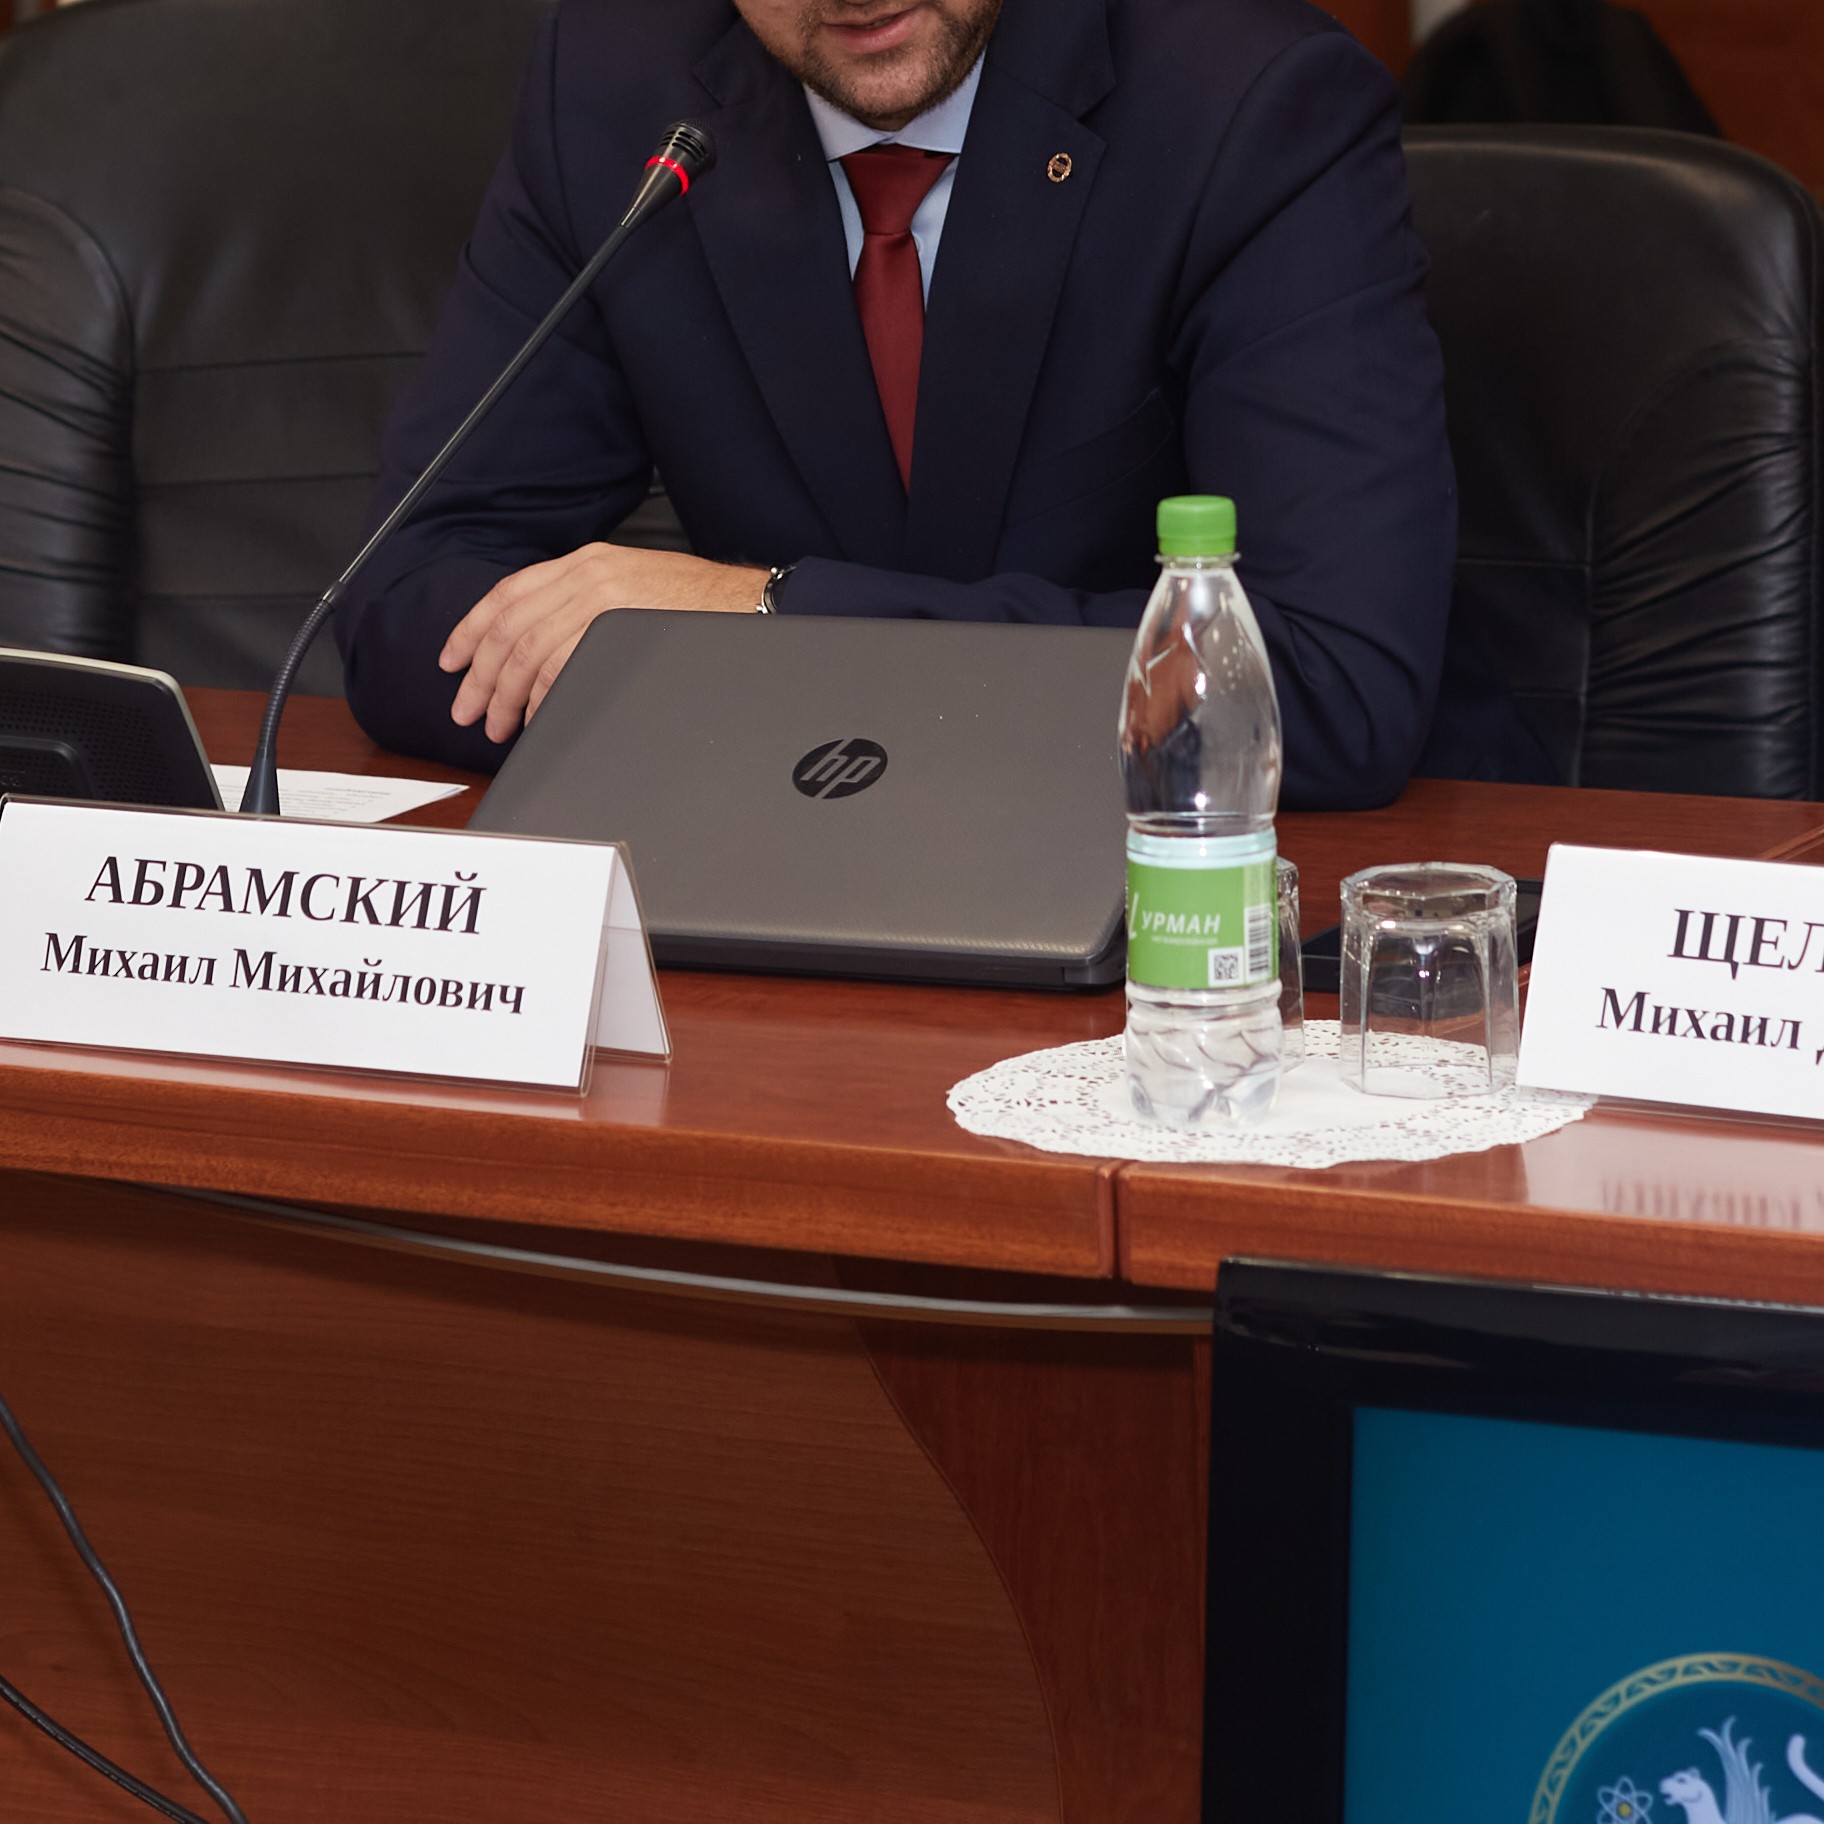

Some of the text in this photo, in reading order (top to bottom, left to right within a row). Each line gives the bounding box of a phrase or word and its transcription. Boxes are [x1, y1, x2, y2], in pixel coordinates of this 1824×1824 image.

[793, 738, 888, 799] hp
[85, 854, 487, 935] АБРАМСКИЙ
[1142, 910, 1222, 936] УРМАН
[39, 932, 526, 1017] Михаил Михайлович
[1595, 987, 1802, 1050] Михаил
